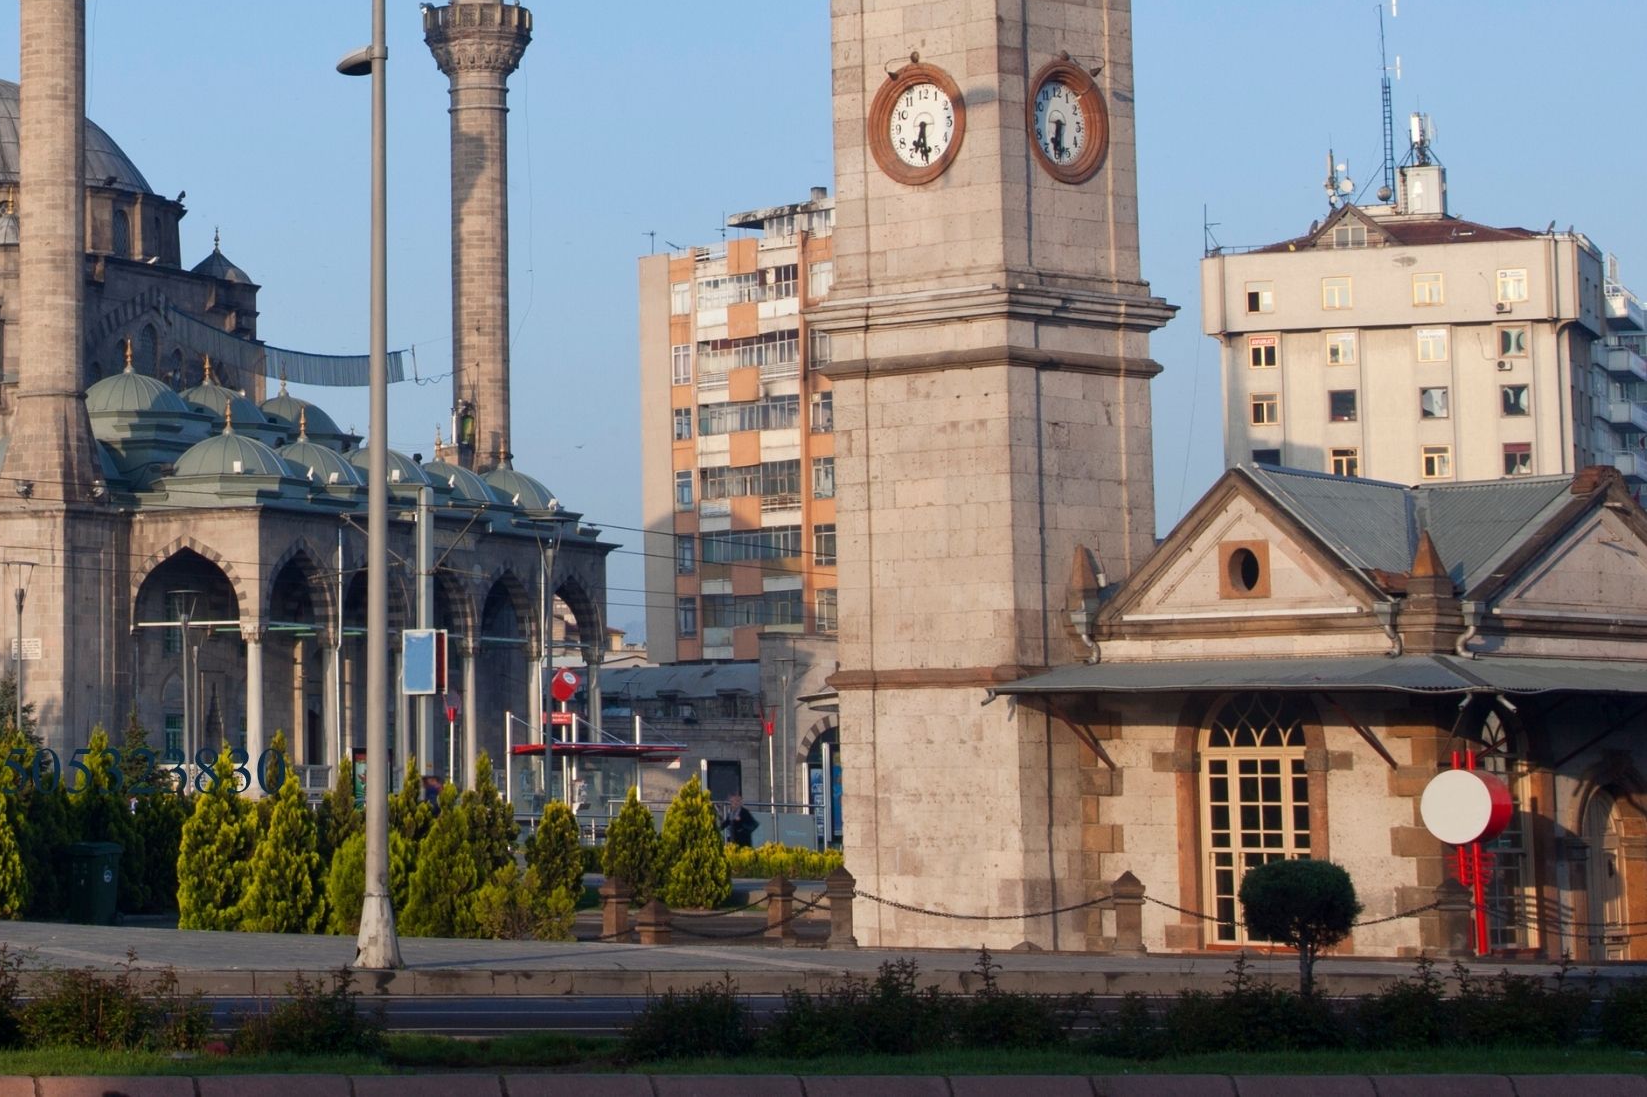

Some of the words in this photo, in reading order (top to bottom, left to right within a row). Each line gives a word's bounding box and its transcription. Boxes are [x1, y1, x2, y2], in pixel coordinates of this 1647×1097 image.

[919, 89, 929, 100] 12
[934, 91, 938, 101] 1
[1042, 90, 1049, 100] 11
[1052, 86, 1062, 98] 12
[906, 96, 913, 107] 11
[1065, 93, 1069, 104] 1
[943, 100, 949, 111] 2
[1035, 101, 1044, 112] 10
[1072, 105, 1078, 116] 2
[898, 110, 908, 121] 10
[947, 115, 953, 128] 3
[895, 124, 902, 135] 9
[1075, 122, 1081, 133] 3
[943, 132, 948, 143] 4
[1037, 128, 1042, 140] 8
[899, 137, 906, 149] 8
[1044, 142, 1050, 153] 7
[1073, 136, 1078, 148] 4
[909, 147, 916, 158] 7
[934, 145, 941, 155] 5
[1065, 147, 1071, 159] 5
